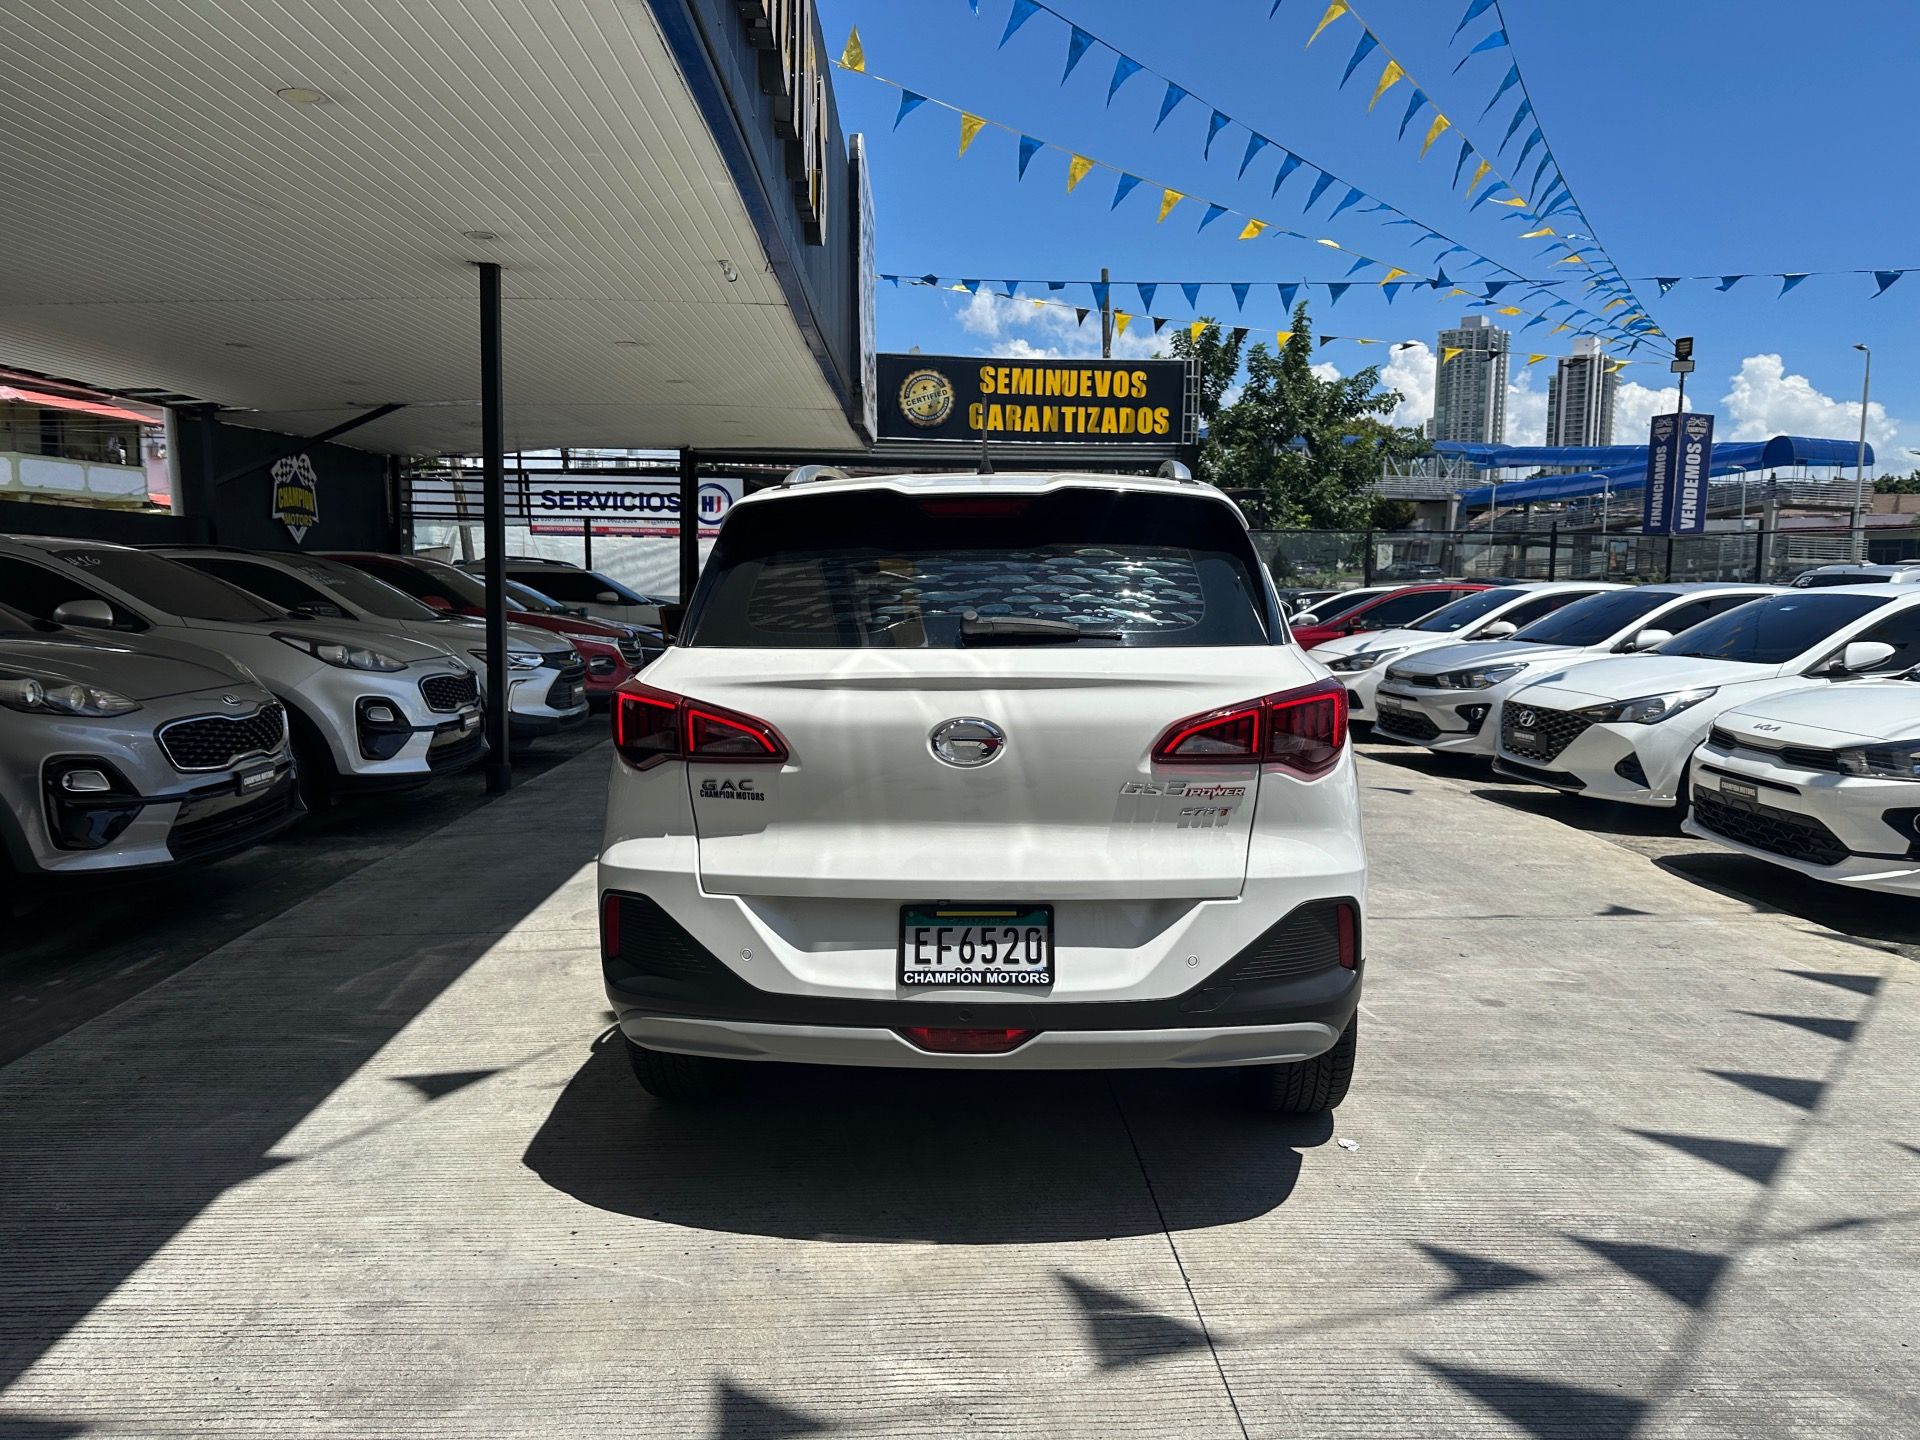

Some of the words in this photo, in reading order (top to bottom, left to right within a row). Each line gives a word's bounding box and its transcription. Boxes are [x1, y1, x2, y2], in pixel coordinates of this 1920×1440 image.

[979, 365, 1148, 399] SEMINUEVOS
[905, 389, 949, 407] CERTIFIED
[968, 402, 1170, 435] GARANTIZADOS
[1650, 444, 1668, 528] FINANCIAMOS
[1679, 442, 1703, 530] VENDEMOS
[277, 486, 315, 513] CHAMPION
[540, 489, 681, 513] SERVICIOS
[701, 495, 722, 514] HJ
[283, 512, 313, 528] MOTORS
[700, 789, 735, 799] CHAMPION
[736, 791, 765, 801] MOTORS
[701, 779, 754, 792] GAC
[1186, 784, 1247, 800] POWER
[914, 927, 1043, 966] EF6520
[903, 972, 982, 984] CHAMPION
[986, 972, 1050, 984] MOTORS
